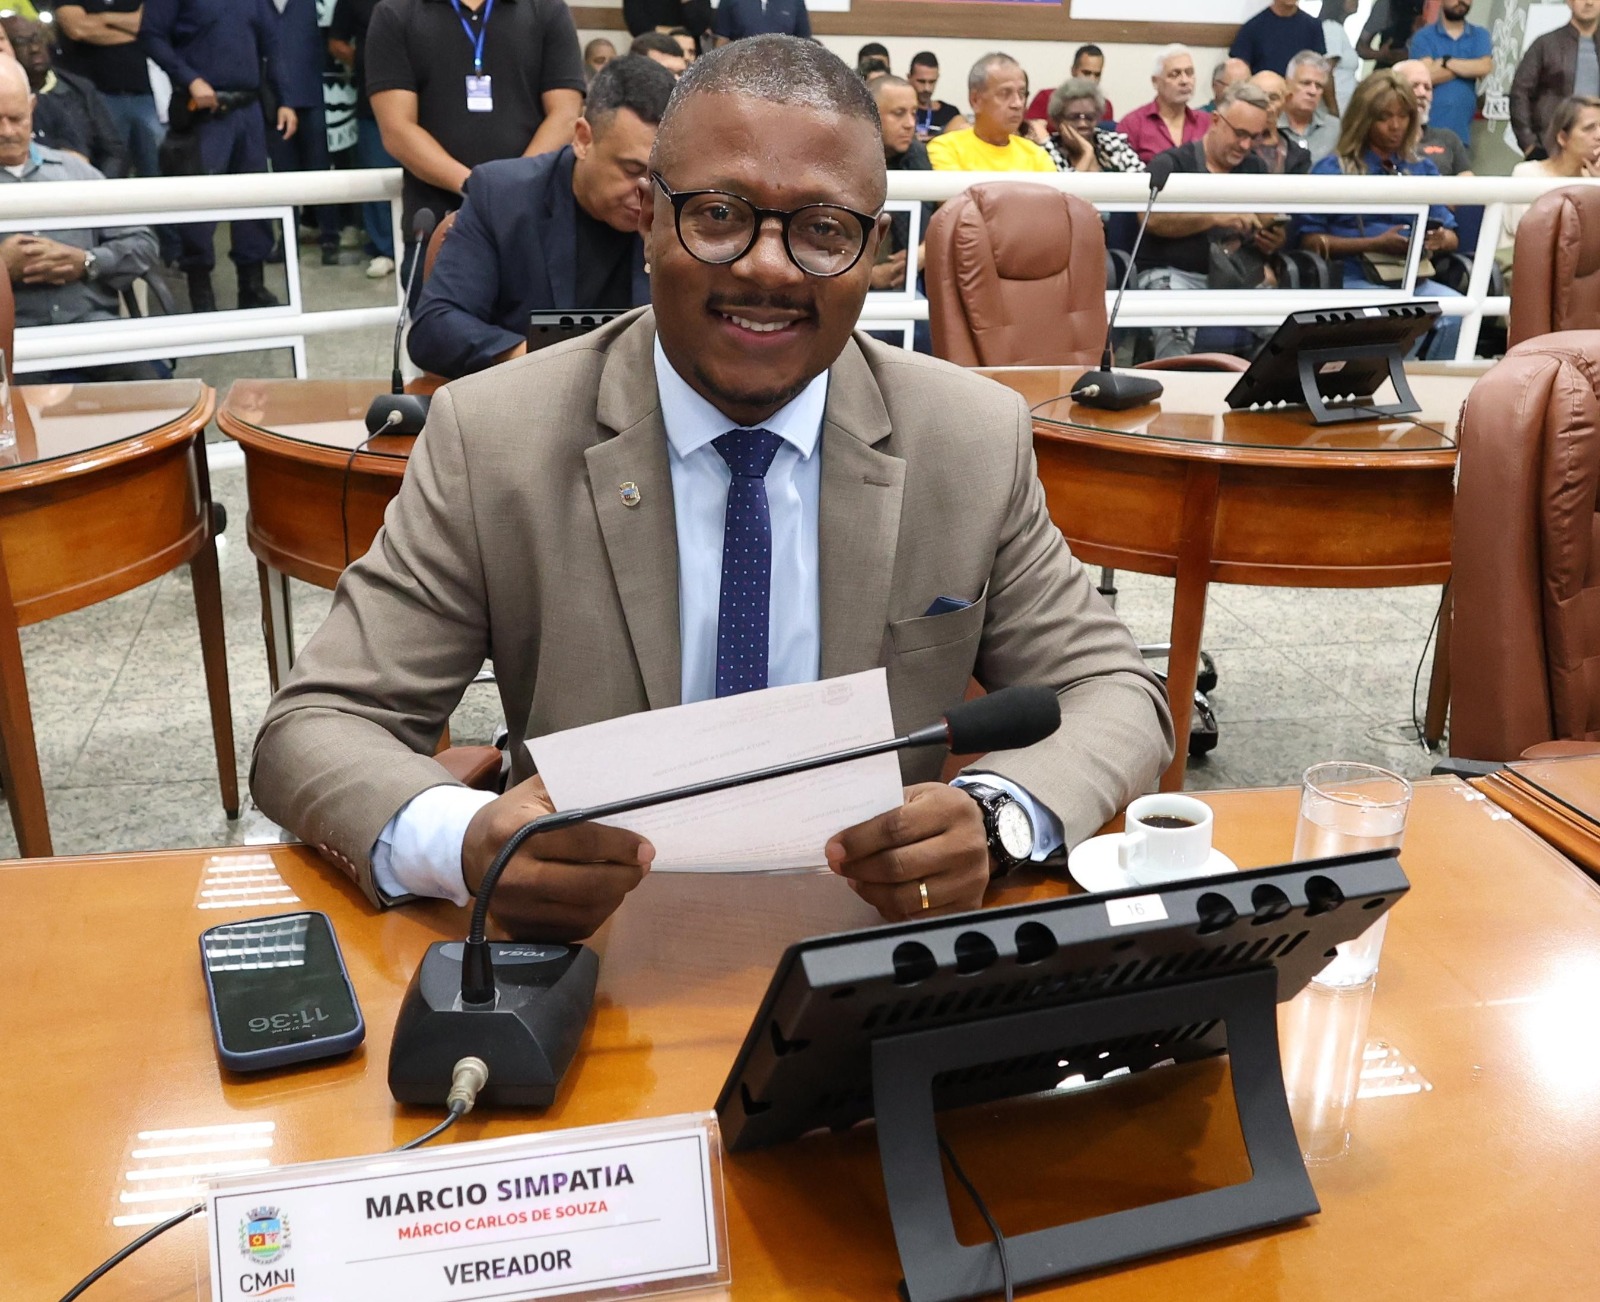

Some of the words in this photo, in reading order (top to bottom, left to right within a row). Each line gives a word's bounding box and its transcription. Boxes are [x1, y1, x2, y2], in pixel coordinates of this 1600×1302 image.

[1127, 902, 1145, 916] 16
[248, 1007, 330, 1033] 11:36
[366, 1183, 487, 1219] MARCIO
[497, 1163, 635, 1202] SIMPATIA
[398, 1220, 461, 1240] MÁRCIO
[465, 1213, 527, 1231] CARLOS
[531, 1207, 552, 1222] DE
[555, 1200, 608, 1219] SOUZA
[239, 1267, 295, 1293] CMNI
[443, 1249, 572, 1286] VEREADOR
